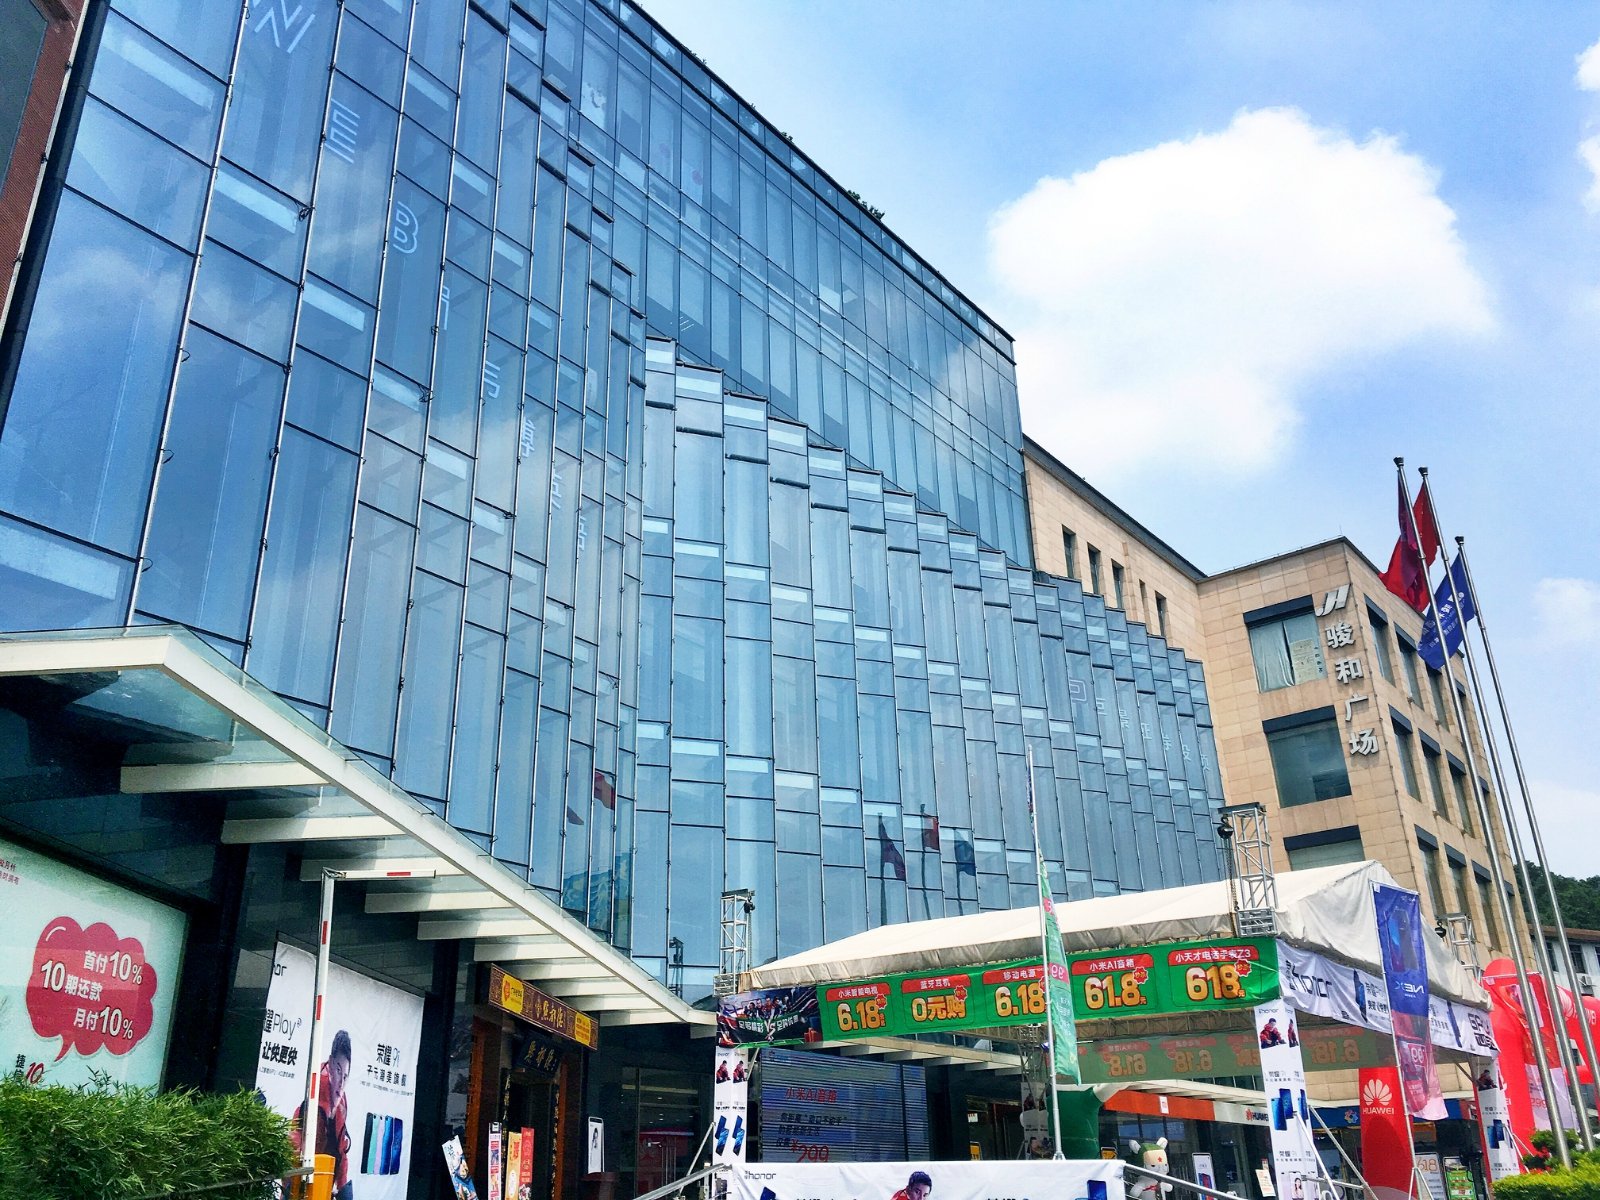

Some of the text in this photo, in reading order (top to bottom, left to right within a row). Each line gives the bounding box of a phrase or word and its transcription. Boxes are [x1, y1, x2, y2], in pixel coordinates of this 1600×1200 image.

[1325, 620, 1379, 756] 骏和广场
[1089, 959, 1135, 972] 小米AI音箱
[1363, 1107, 1394, 1115] HUAWEI
[748, 1171, 776, 1180] honor
